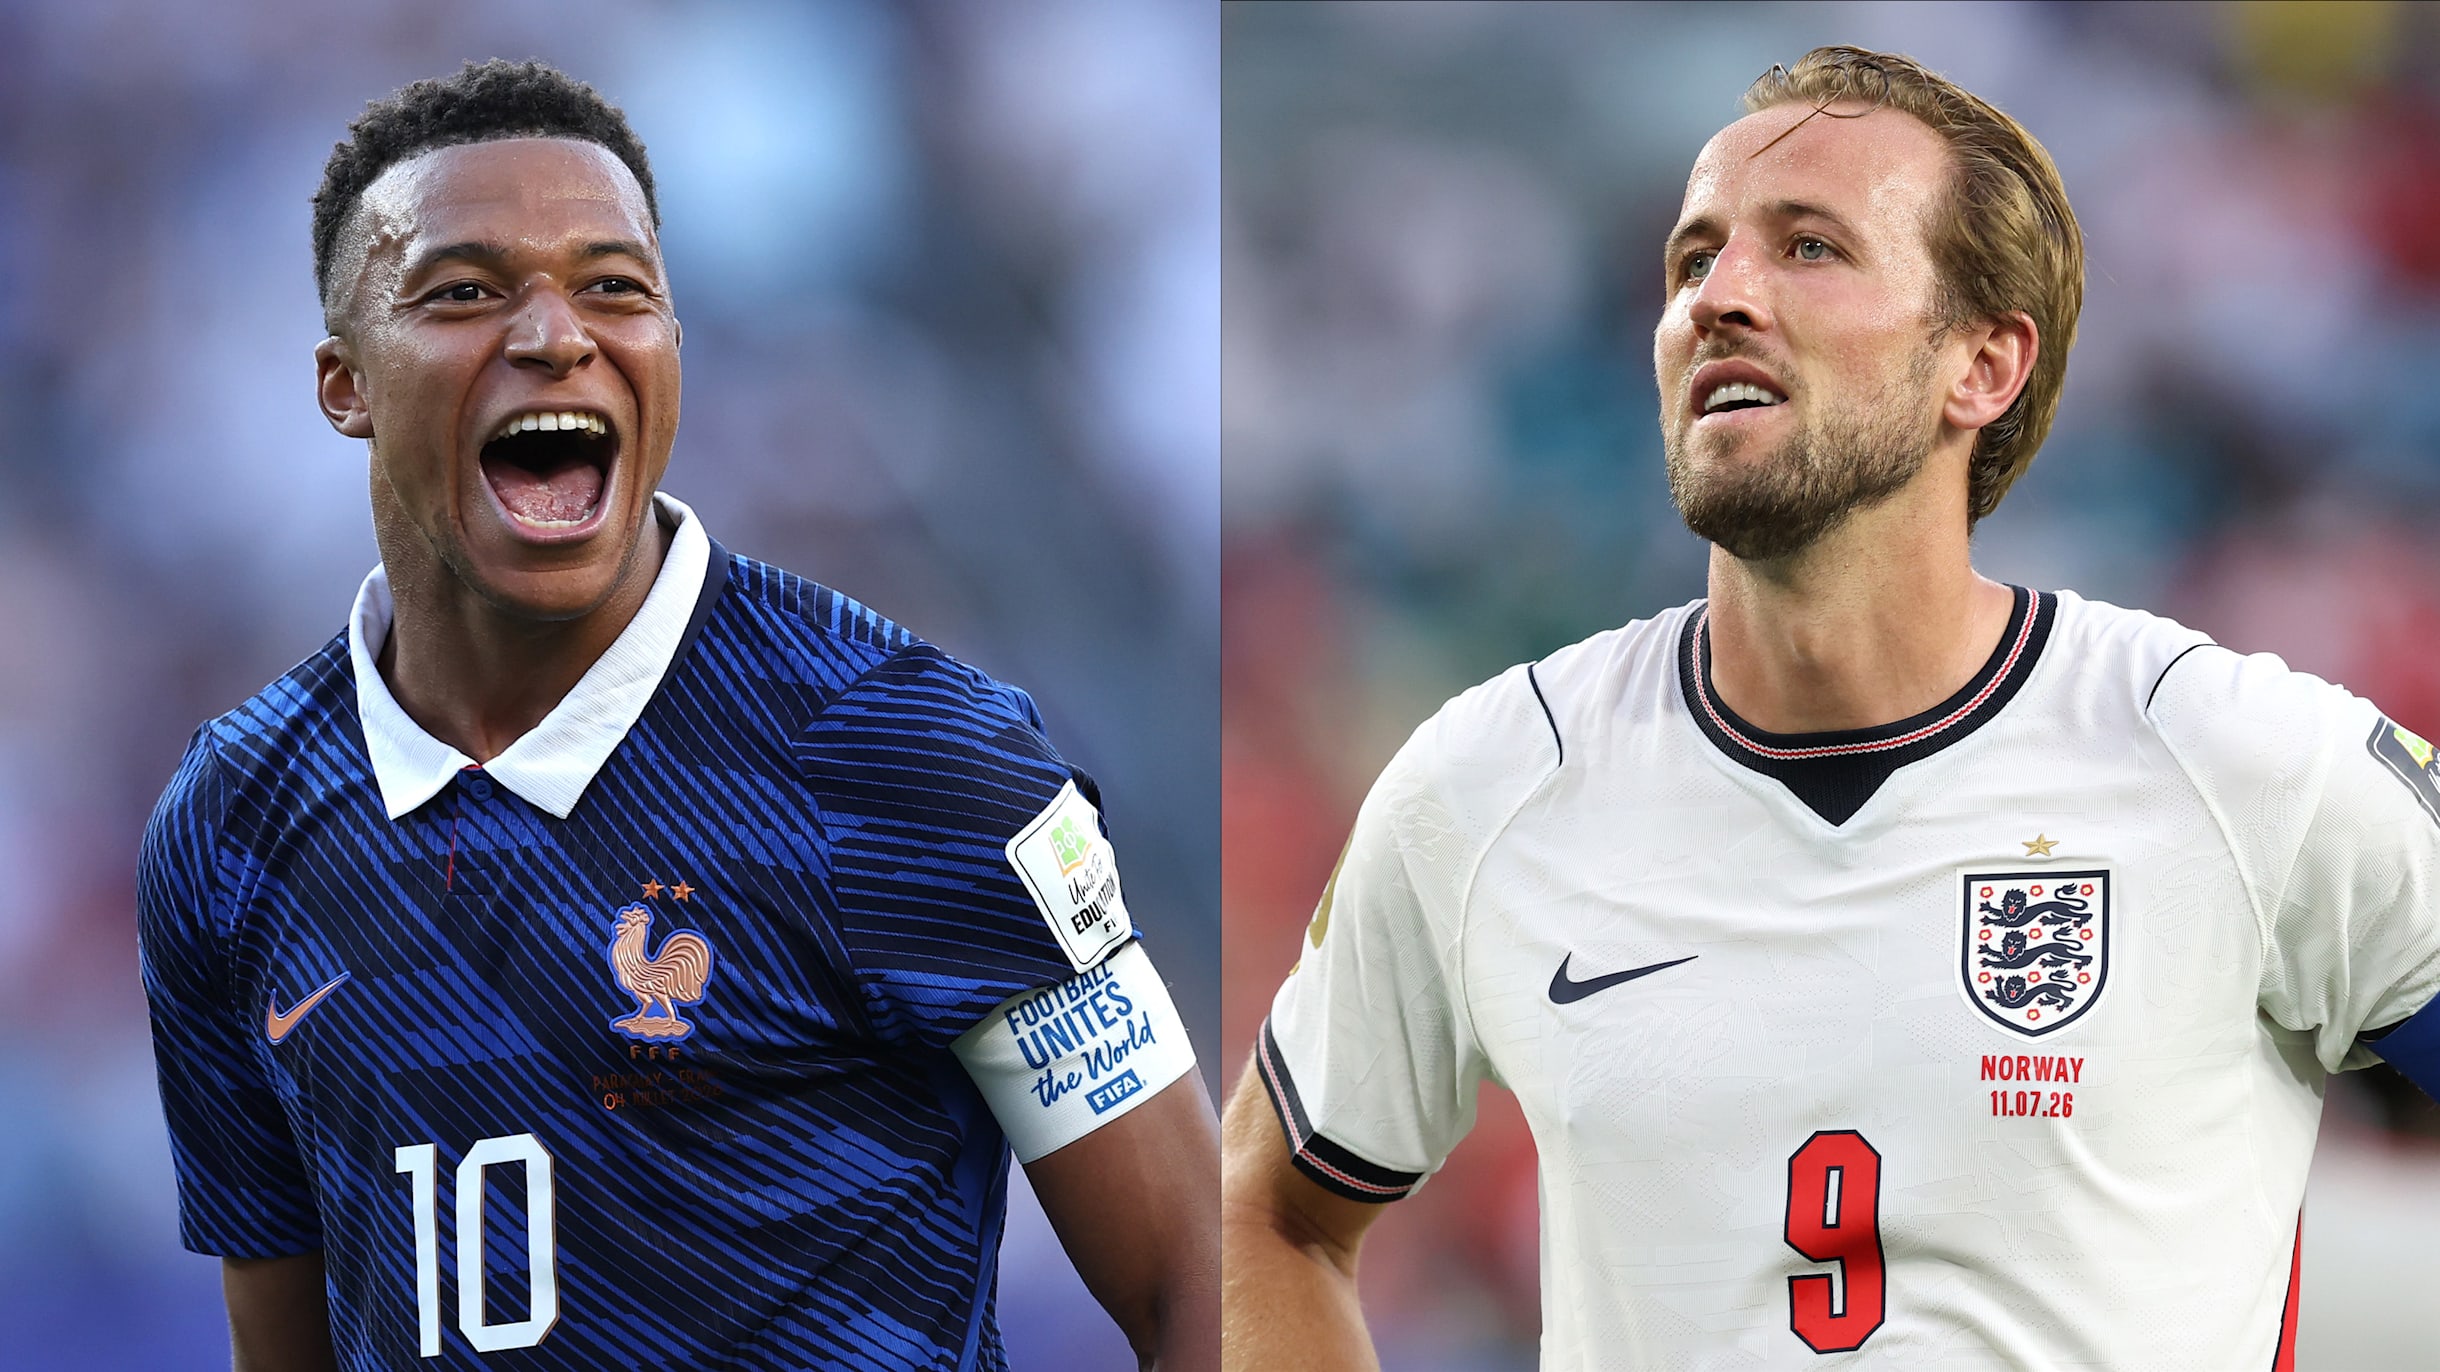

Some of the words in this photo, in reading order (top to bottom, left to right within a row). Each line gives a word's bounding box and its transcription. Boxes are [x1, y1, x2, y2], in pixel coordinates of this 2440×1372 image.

[1103, 918, 1117, 933] FI
[1003, 961, 1114, 1036] FOOTBALL
[1017, 981, 1133, 1070] UNITES
[1031, 1068, 1083, 1108] the
[1081, 1011, 1157, 1080] World
[1092, 1076, 1139, 1110] FIFA
[1981, 1055, 2084, 1083] NORWAY
[1990, 1090, 2074, 1118] 11.07.26
[395, 1133, 561, 1358] 10
[1784, 1129, 1887, 1355] 9
